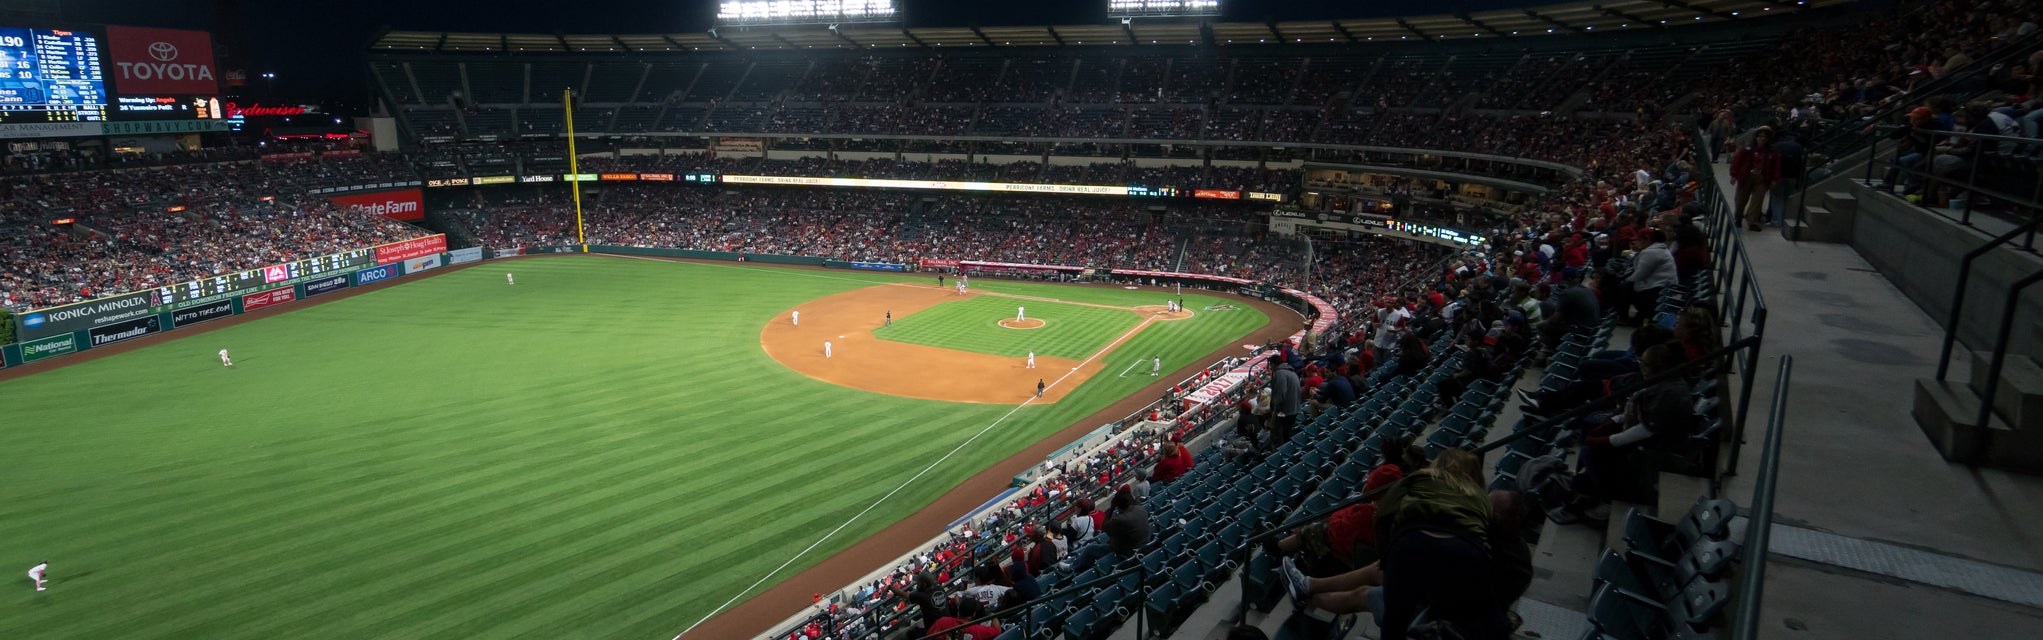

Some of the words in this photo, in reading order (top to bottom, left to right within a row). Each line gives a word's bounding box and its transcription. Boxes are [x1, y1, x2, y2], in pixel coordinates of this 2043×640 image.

[117, 62, 214, 80] TOYOTA
[226, 102, 305, 118] Budweiser
[20, 123, 84, 131] MANAGEMENT
[103, 121, 212, 134] SHOPWAVY.COM
[8, 140, 38, 153] Captain
[386, 201, 416, 214] Farm
[410, 241, 424, 250] Hoag
[424, 237, 441, 246] Health
[310, 272, 327, 280] WORLD
[361, 268, 386, 282] ARCO
[192, 295, 220, 306] DOMINION
[222, 290, 243, 299] FREIGHT
[50, 306, 96, 322] KONICA
[98, 297, 146, 312] MINOLTA
[94, 308, 148, 324] reshapework.com
[175, 310, 198, 322] NITTO
[199, 304, 230, 317] TIRE.COM
[94, 326, 148, 344] Thermador
[36, 338, 72, 352] National
[1199, 377, 1234, 396] 2017
